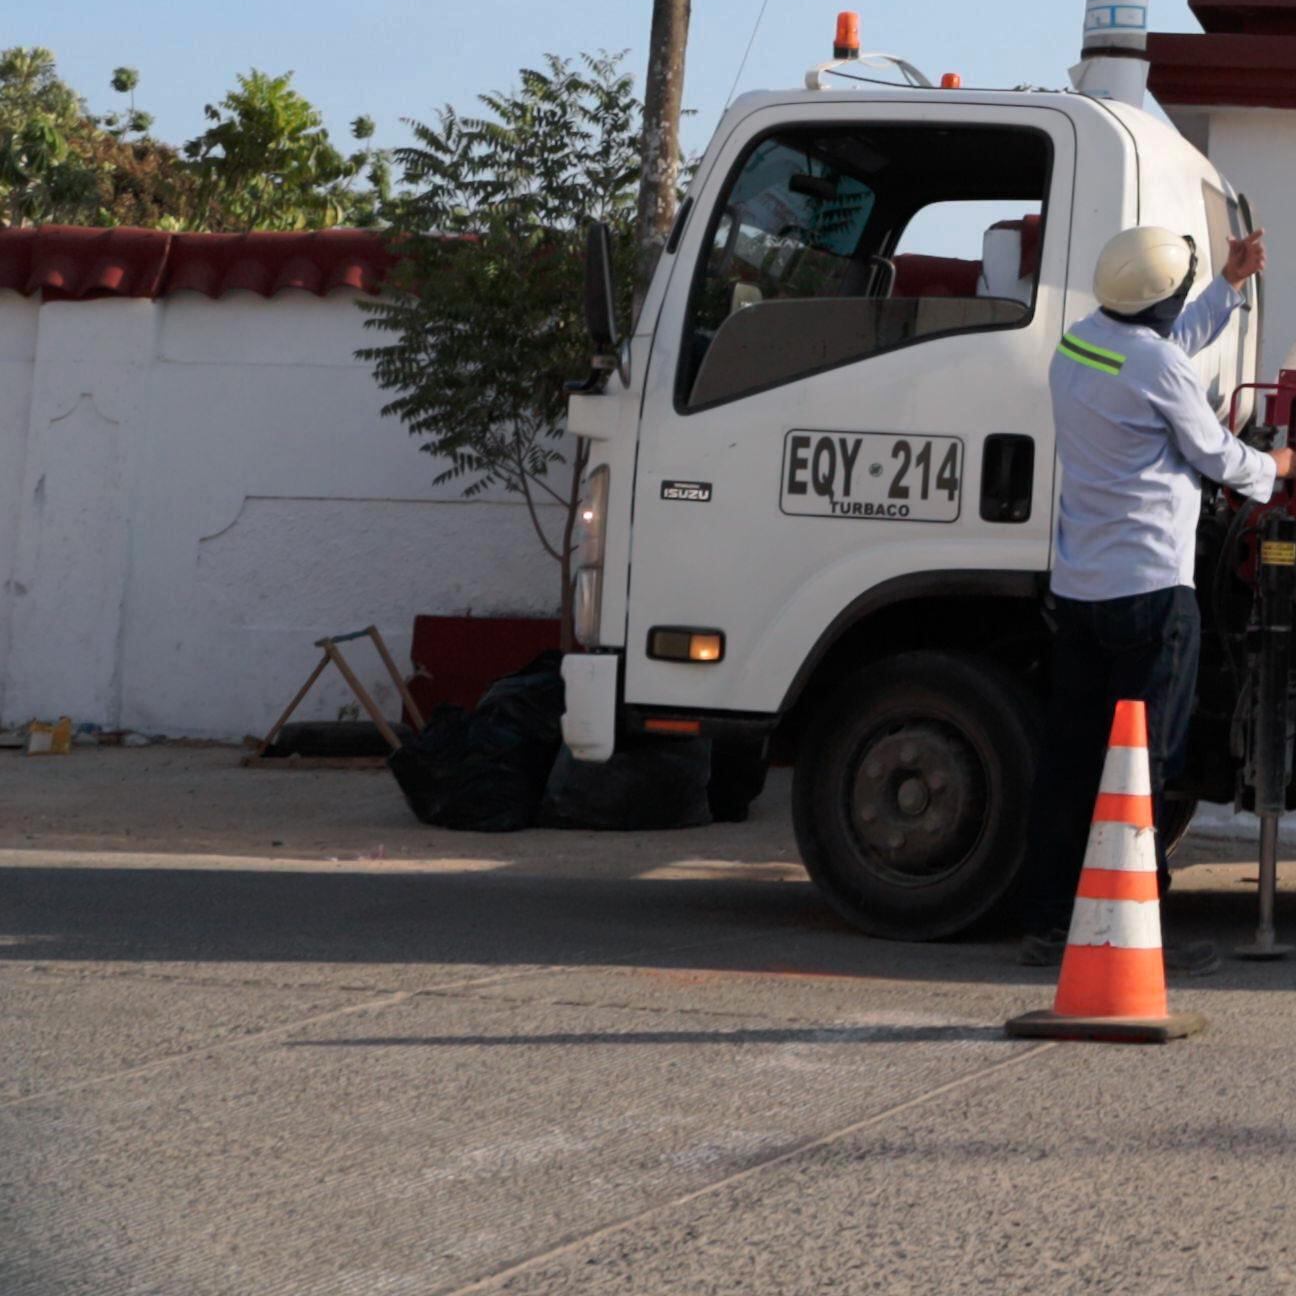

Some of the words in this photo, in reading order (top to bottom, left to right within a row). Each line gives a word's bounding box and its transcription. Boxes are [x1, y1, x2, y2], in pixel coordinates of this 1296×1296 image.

[787, 435, 862, 503] EQY
[888, 440, 959, 502] 214
[664, 488, 710, 501] ISUZU
[829, 501, 910, 518] TURBACO
